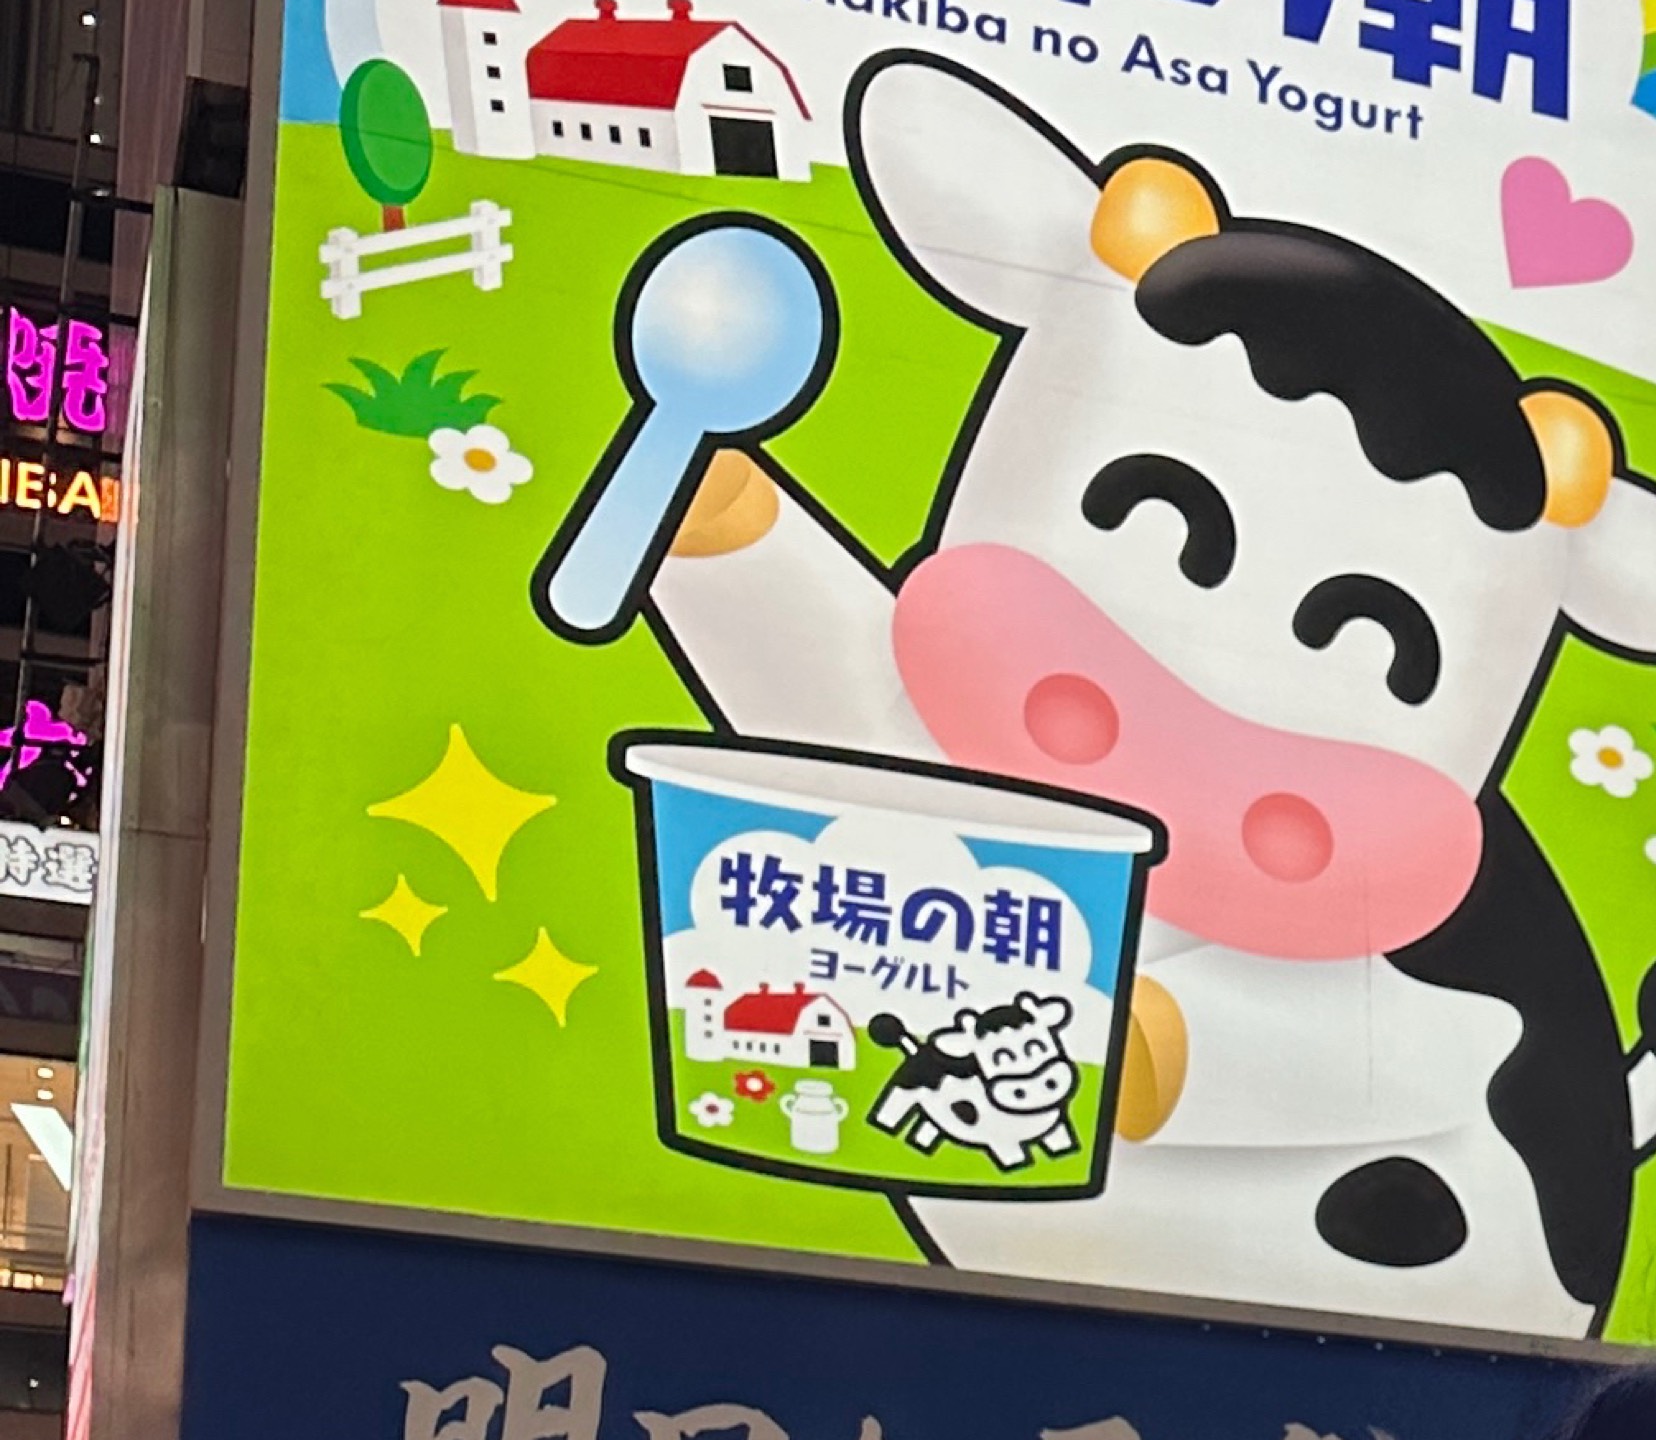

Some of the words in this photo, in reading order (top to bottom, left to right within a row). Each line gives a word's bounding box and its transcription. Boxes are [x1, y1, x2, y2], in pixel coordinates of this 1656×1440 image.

[1033, 24, 1099, 64] no
[1123, 35, 1229, 96] Asa
[1247, 61, 1425, 142] Yogurt
[720, 852, 1062, 970] 牧場の朝
[809, 948, 970, 999] ヨーグルト
